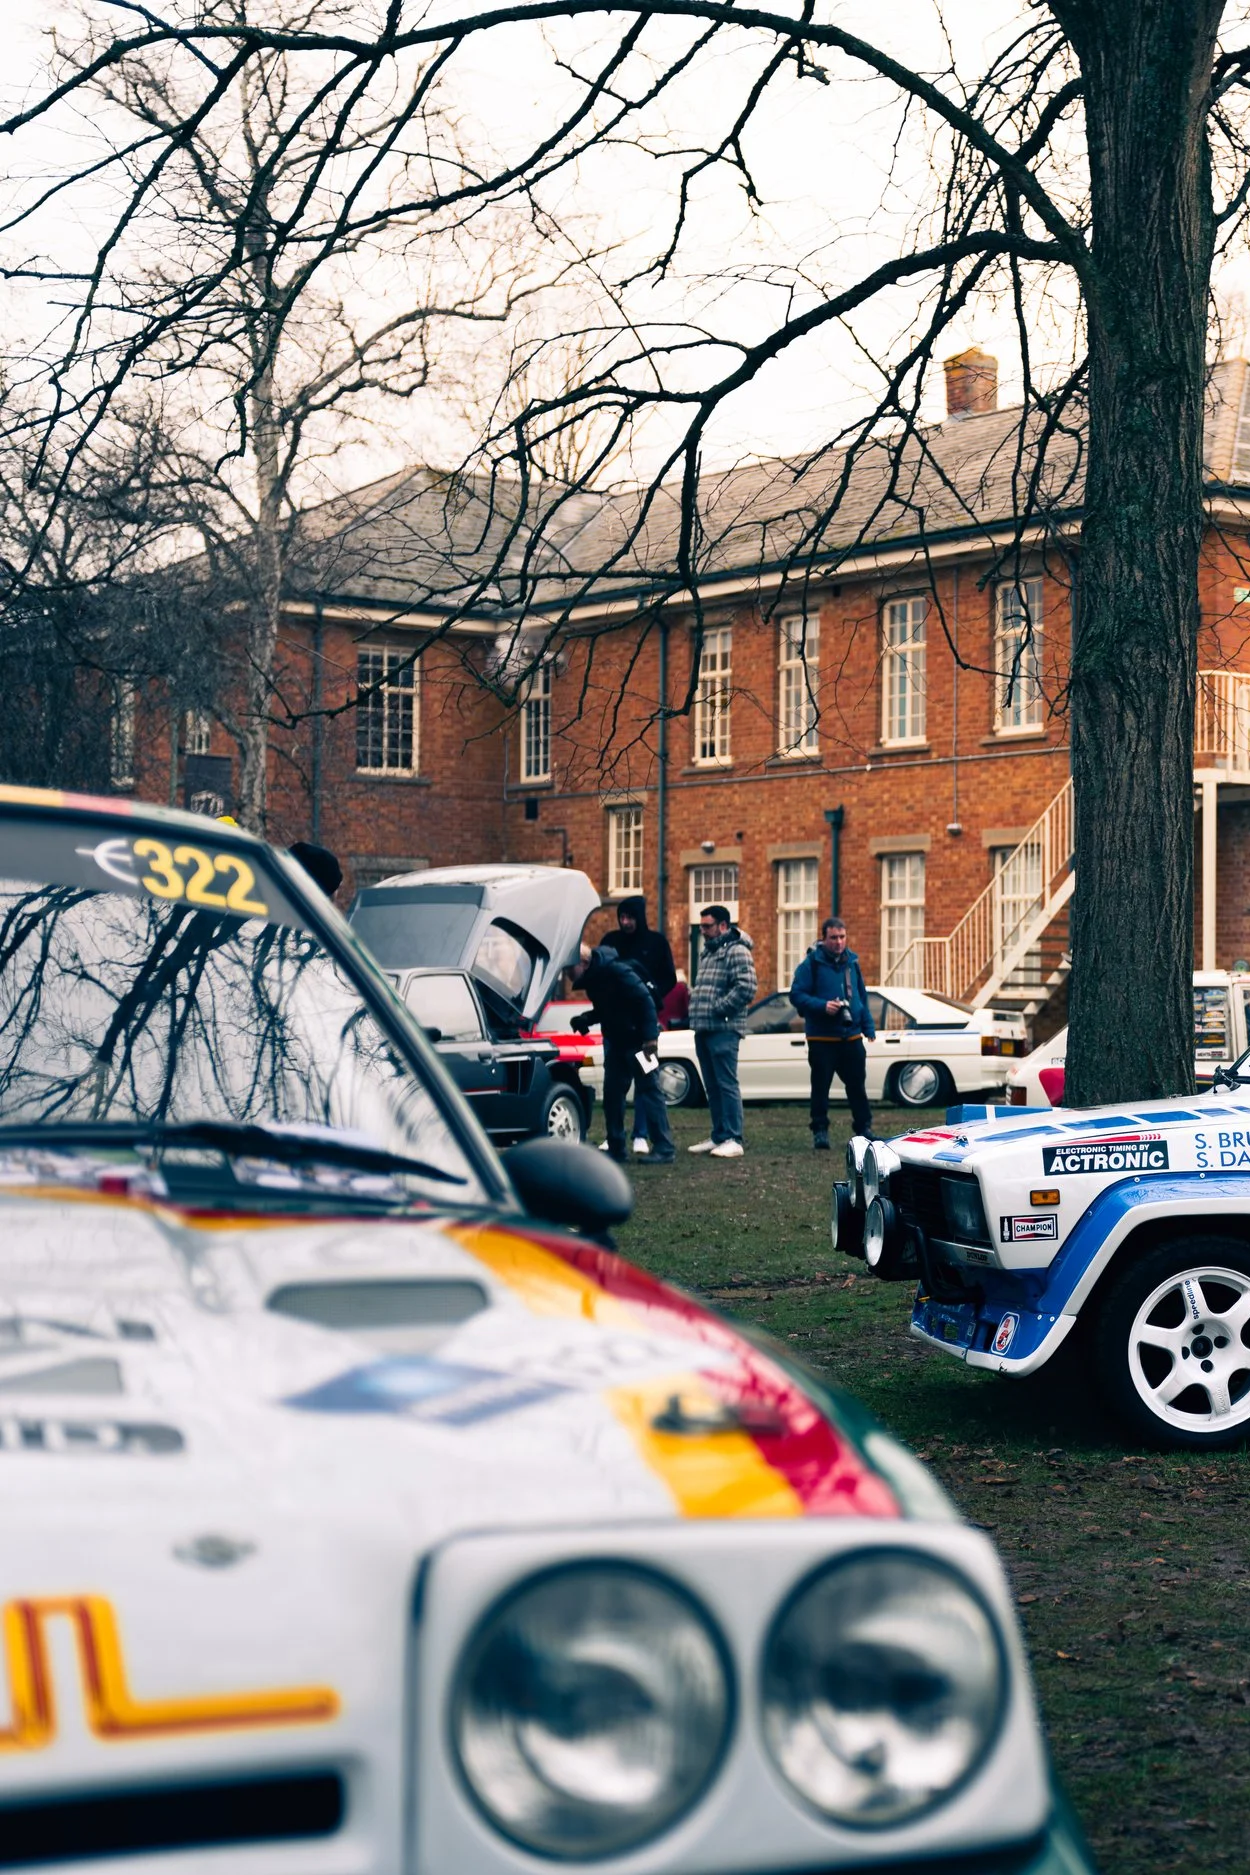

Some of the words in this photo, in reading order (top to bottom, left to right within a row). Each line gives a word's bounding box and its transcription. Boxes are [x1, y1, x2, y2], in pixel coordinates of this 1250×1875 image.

[133, 838, 269, 916] 322
[1195, 1133, 1212, 1149] S.
[1056, 1145, 1107, 1155] ELECTRONIC
[1109, 1144, 1137, 1152] TIMING
[1050, 1151, 1165, 1172] ACTRONIC
[1196, 1152, 1214, 1167] S.
[1016, 1222, 1052, 1233] CHAMPION
[1184, 1280, 1199, 1320] speedline
